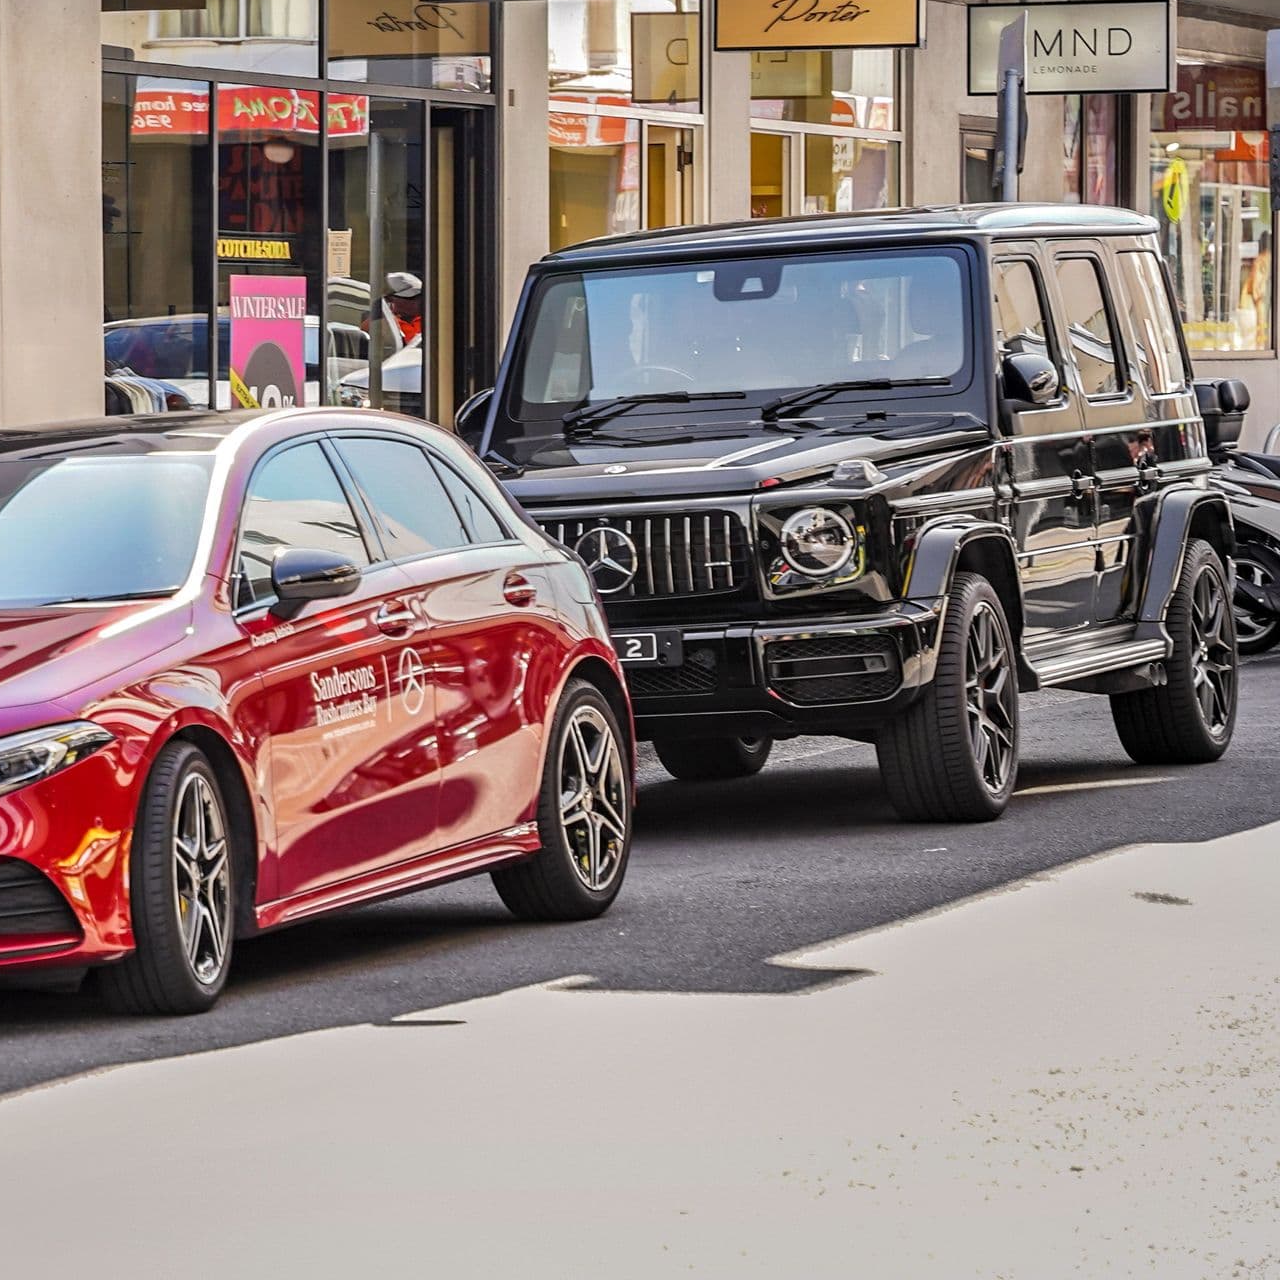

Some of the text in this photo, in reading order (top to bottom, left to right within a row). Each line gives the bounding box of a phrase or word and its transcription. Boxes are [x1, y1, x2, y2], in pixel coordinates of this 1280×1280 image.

[1033, 65, 1098, 74] LEMONADE
[230, 295, 277, 319] WINTER
[310, 665, 376, 702] Sandersons
